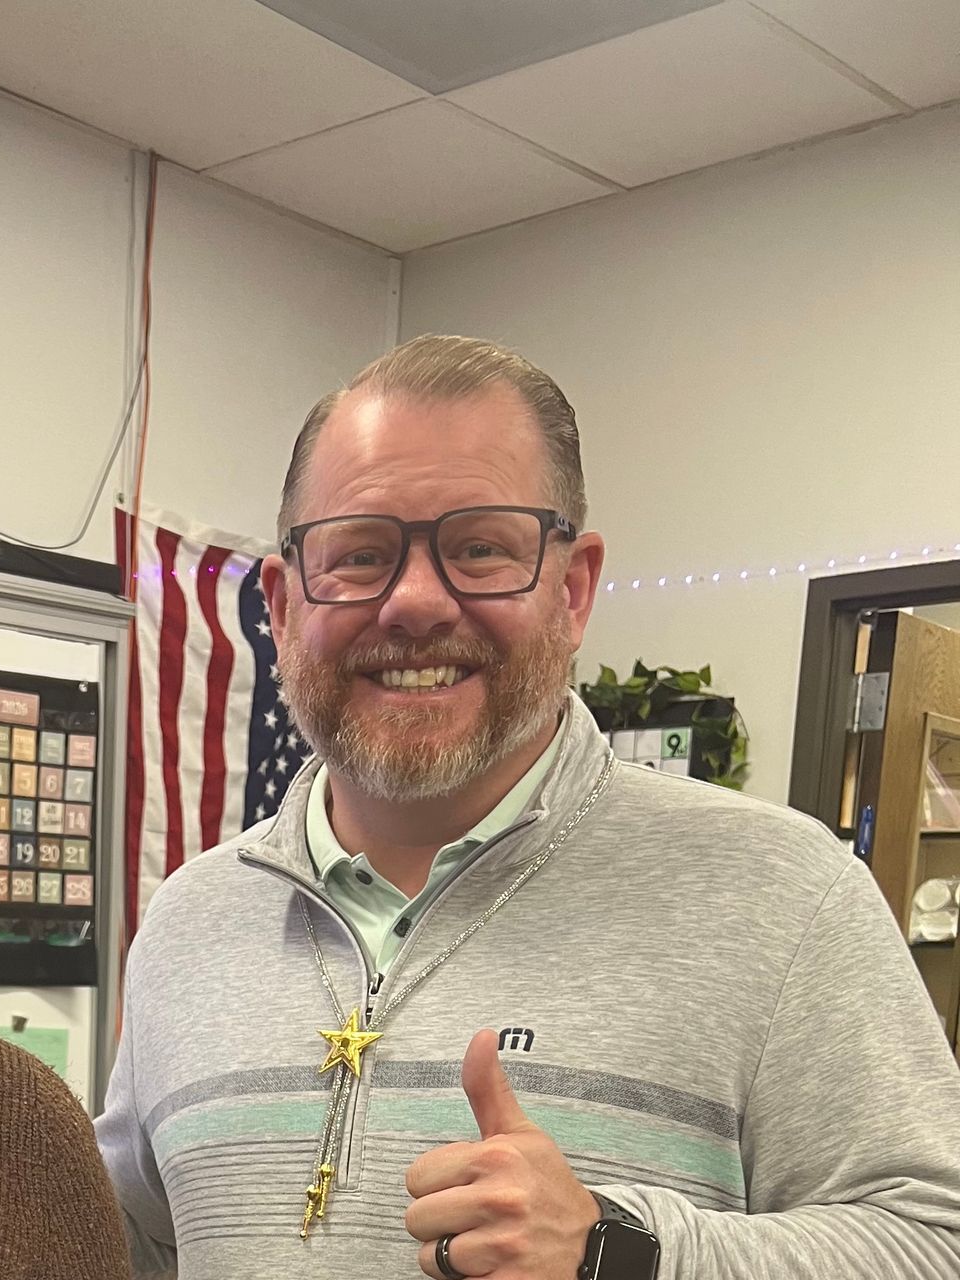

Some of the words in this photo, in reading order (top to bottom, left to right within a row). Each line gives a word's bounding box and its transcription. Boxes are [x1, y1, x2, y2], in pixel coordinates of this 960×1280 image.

[20, 773, 34, 790] 5
[46, 775, 57, 792] 6
[74, 778, 85, 795] 7
[16, 808, 33, 825] 12
[68, 812, 86, 830] 14
[16, 843, 34, 863] 19
[40, 845, 60, 863] 20
[65, 847, 85, 864] 21
[40, 880, 60, 897] 27
